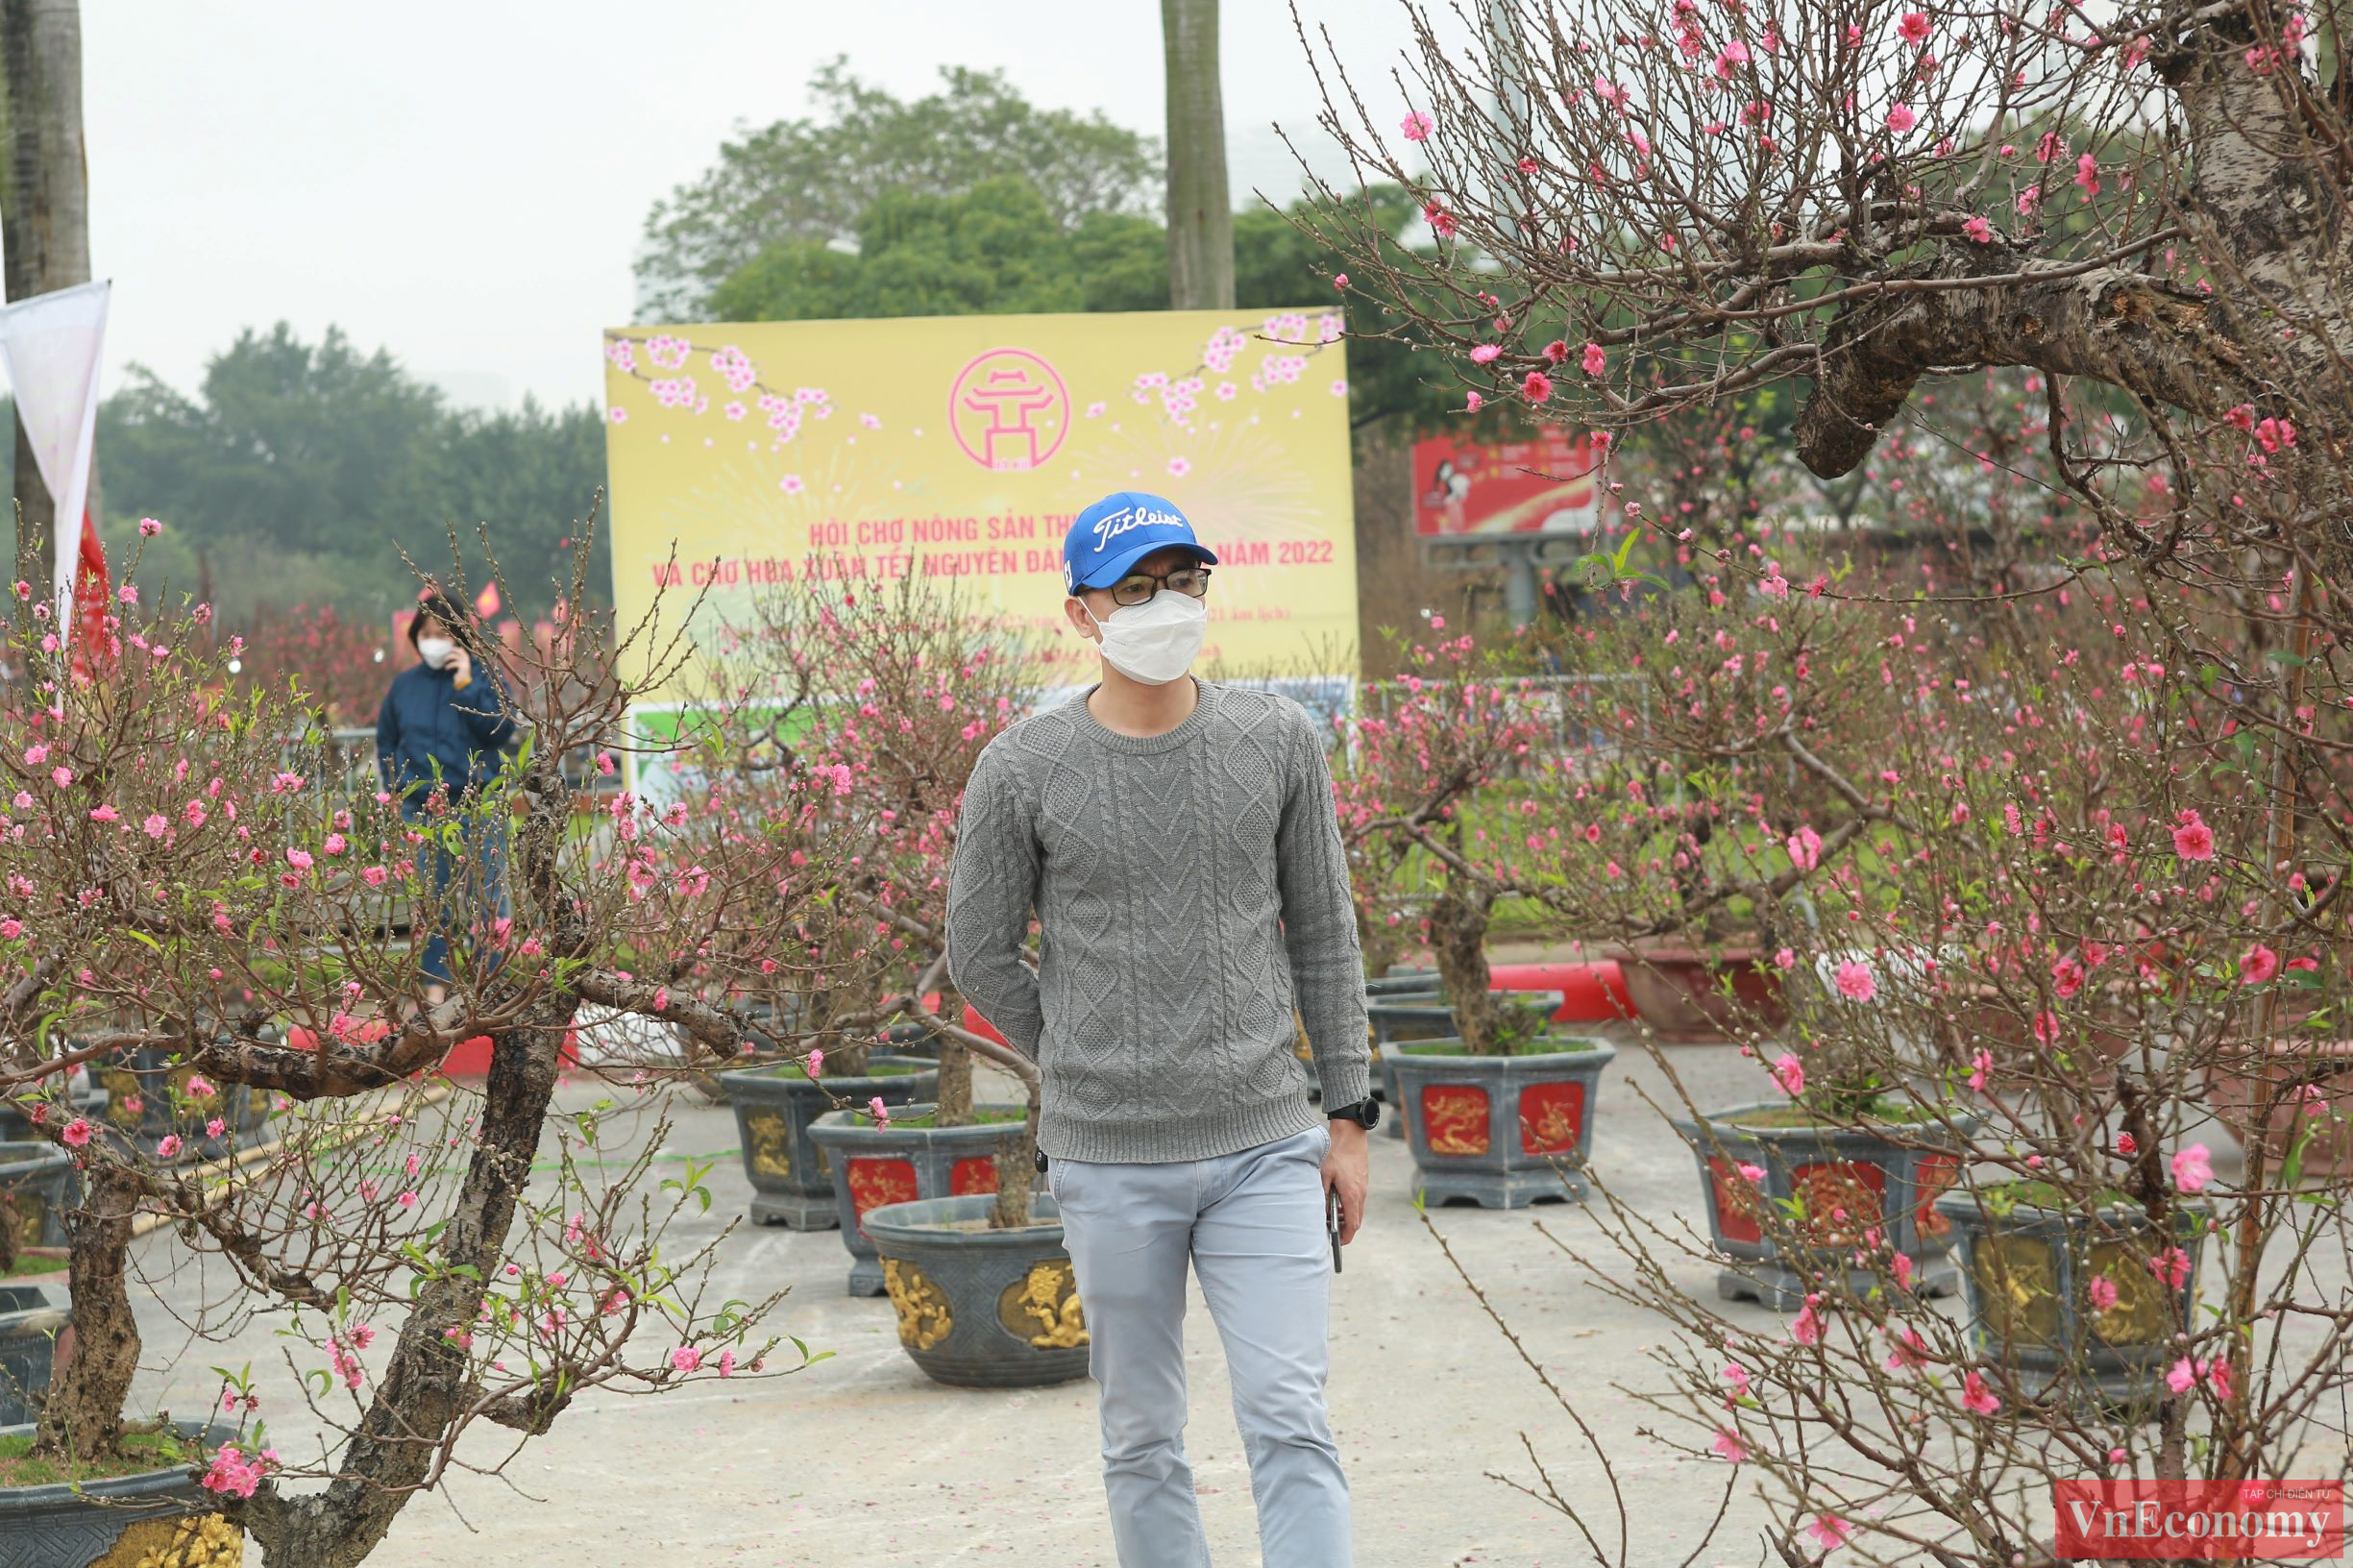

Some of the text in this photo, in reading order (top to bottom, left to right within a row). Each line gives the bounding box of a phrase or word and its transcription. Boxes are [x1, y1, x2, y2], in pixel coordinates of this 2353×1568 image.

[913, 513, 978, 543] NÔNG
[987, 507, 1035, 541] SẢN
[1042, 513, 1077, 538] TH
[1093, 506, 1184, 553] Titleist
[923, 545, 1017, 576] NGUYÊN
[1278, 540, 1334, 565] 2022
